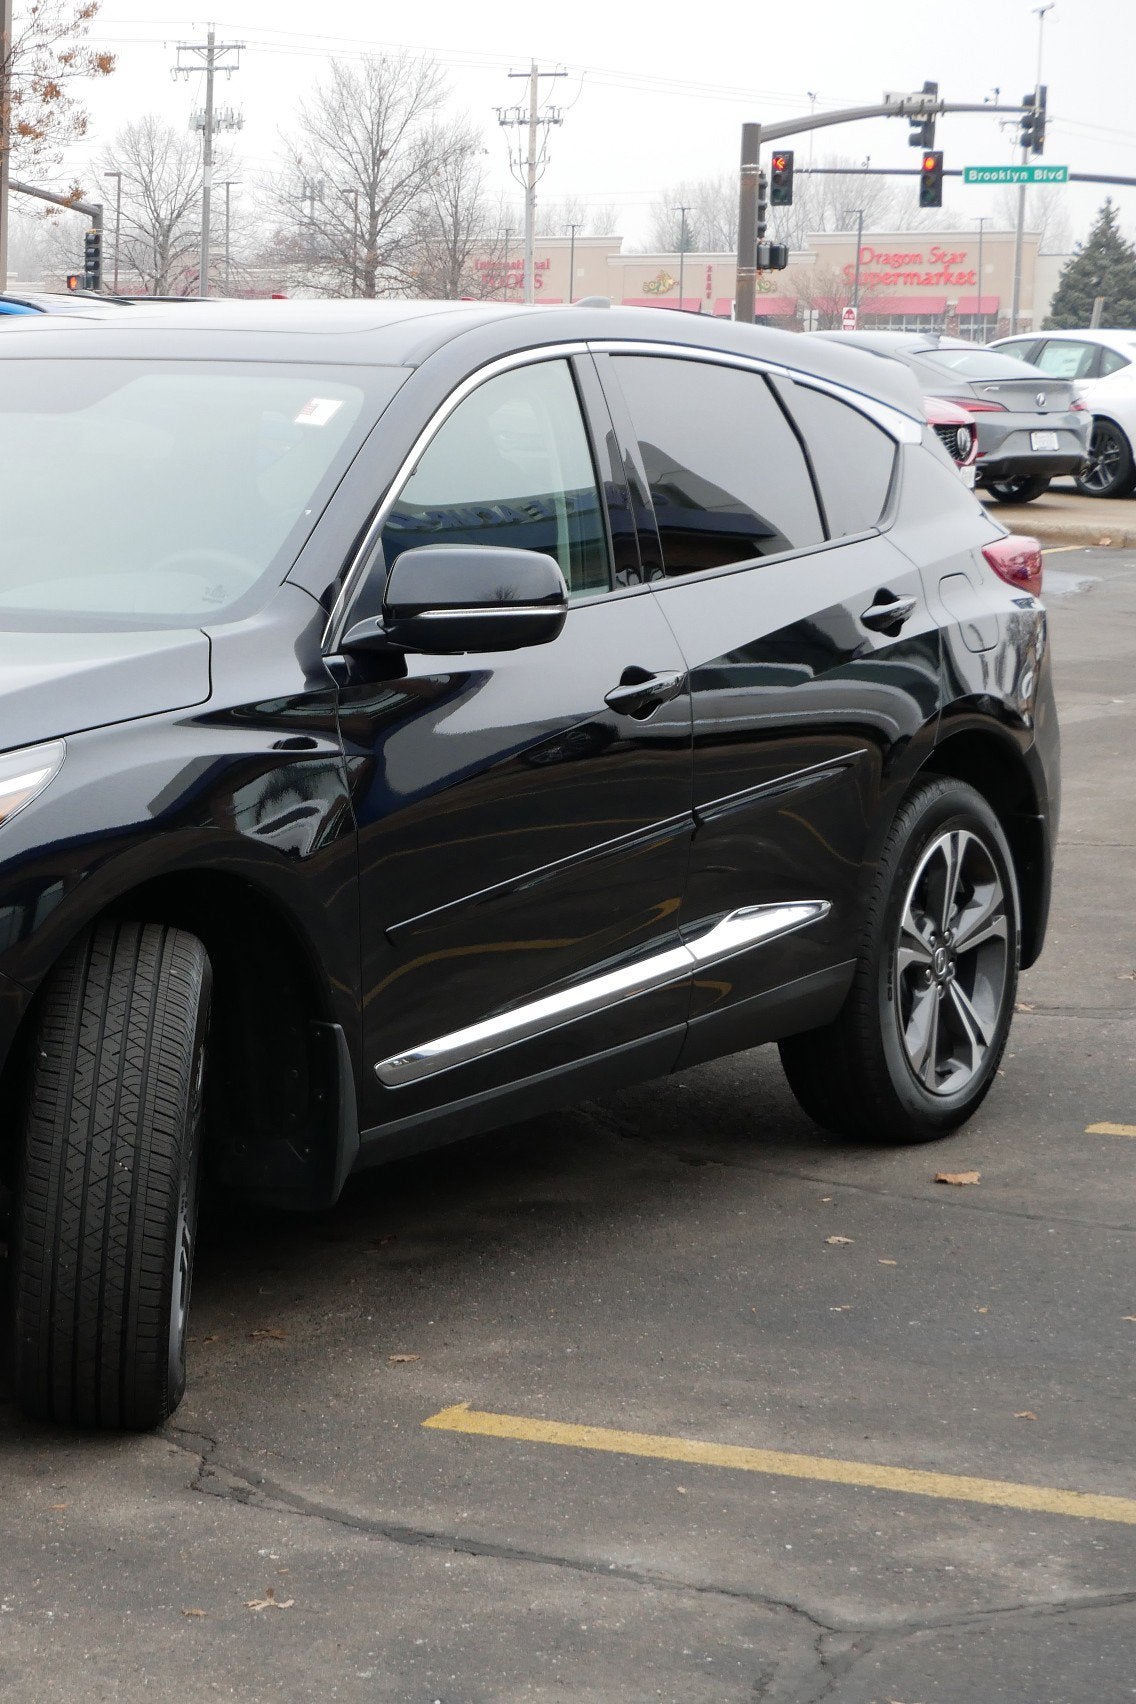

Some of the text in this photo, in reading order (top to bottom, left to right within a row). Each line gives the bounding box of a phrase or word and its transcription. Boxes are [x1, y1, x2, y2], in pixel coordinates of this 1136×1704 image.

[968, 169, 1064, 183] Brooklyn Blvd
[858, 246, 968, 268] Dragon Star
[842, 264, 976, 290] Supermarket
